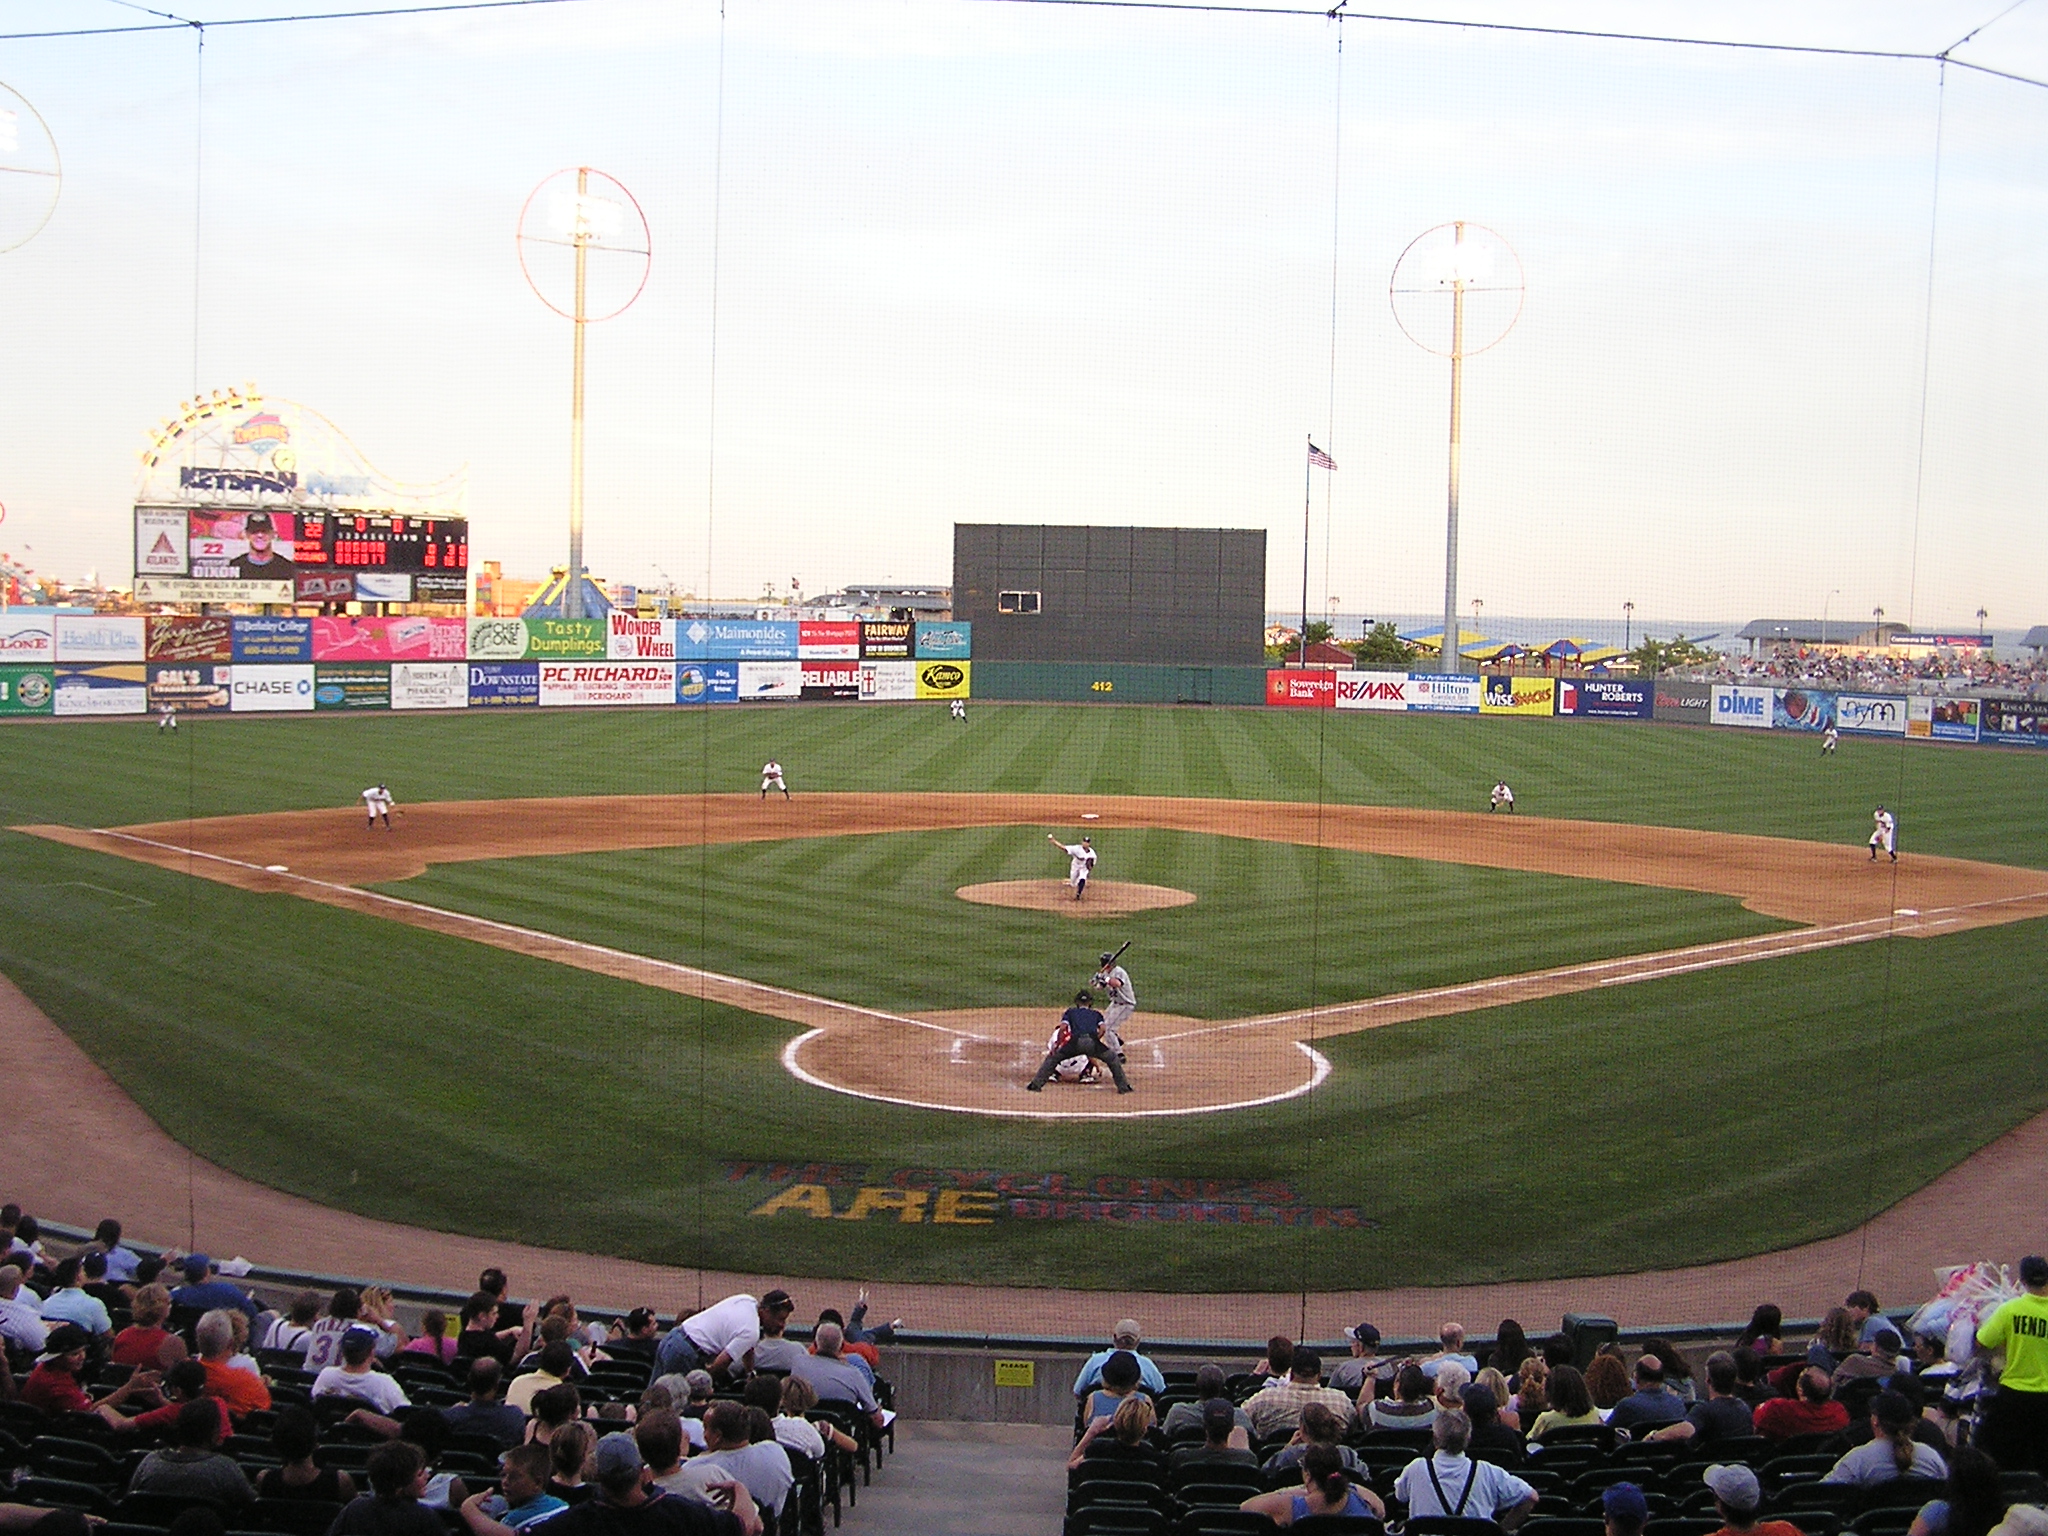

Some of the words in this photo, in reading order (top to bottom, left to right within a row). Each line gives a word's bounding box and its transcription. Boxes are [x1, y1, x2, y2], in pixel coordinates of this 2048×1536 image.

[305, 523, 323, 538] 22
[203, 543, 223, 554] 22
[192, 566, 240, 578] DIXON
[493, 622, 520, 634] CHEF
[545, 621, 592, 639] Tasty
[612, 615, 661, 636] WONDER
[715, 625, 788, 640] Maimonides
[864, 624, 910, 638] FAIRWAY
[493, 633, 517, 646] ONE
[530, 635, 605, 655] Dumplings.
[637, 636, 674, 658] WHEEL
[470, 667, 538, 687] DOWNSTATE
[573, 667, 659, 682] RICHARD
[801, 670, 861, 688] RELIABLE
[924, 666, 962, 689] Kamco
[234, 681, 292, 695] CHASE
[1092, 681, 1113, 692] 412
[1290, 679, 1334, 692] Sovereign
[1432, 683, 1469, 694] Hilton
[1584, 683, 1625, 693] HUNTER
[1290, 689, 1314, 698] Bank
[1484, 691, 1514, 707] WISE
[1512, 687, 1552, 708] SNACKS
[1602, 692, 1644, 703] ROBERTS
[1680, 698, 1709, 710] LIGHT
[891, 1166, 1302, 1202] CYCLONES
[749, 1184, 1000, 1224] ARE
[1008, 1198, 1378, 1229] BROOKLYN
